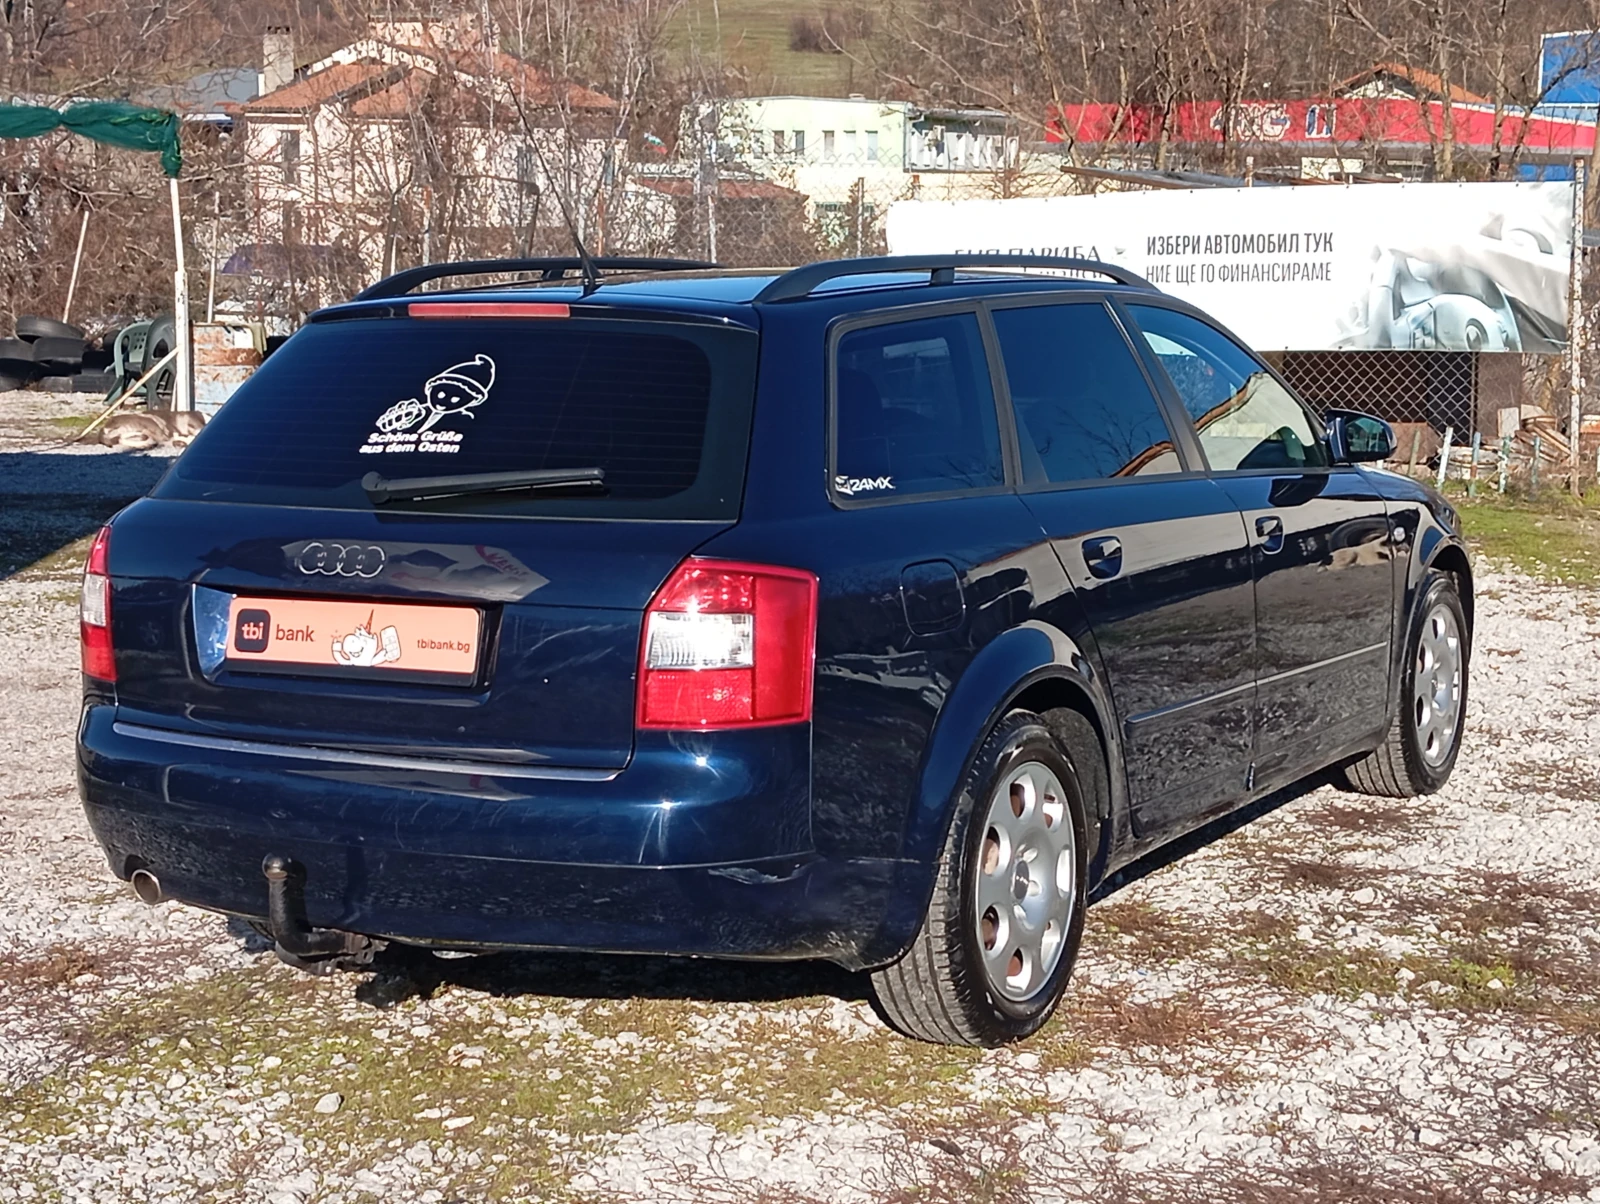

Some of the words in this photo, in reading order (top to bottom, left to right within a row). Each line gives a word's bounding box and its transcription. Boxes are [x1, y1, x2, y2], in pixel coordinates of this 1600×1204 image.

[1147, 236, 1200, 255] ИЗБЕРИ
[1204, 234, 1299, 254] АВТОМОБИЛ
[1304, 232, 1333, 252] ТУК
[1147, 265, 1171, 283] НИЕ
[1176, 264, 1196, 285] ЩЕ
[1201, 264, 1214, 282] ГО
[1218, 262, 1331, 282] ФИНАНСИРАМЕ
[368, 432, 418, 443] Schöne
[421, 430, 463, 442] Grüße
[359, 444, 383, 453] aus
[386, 442, 416, 452] dem
[418, 442, 460, 453] Osten
[242, 622, 264, 640] tbi
[276, 624, 314, 642] bank
[417, 639, 470, 653] tbibank.bg
